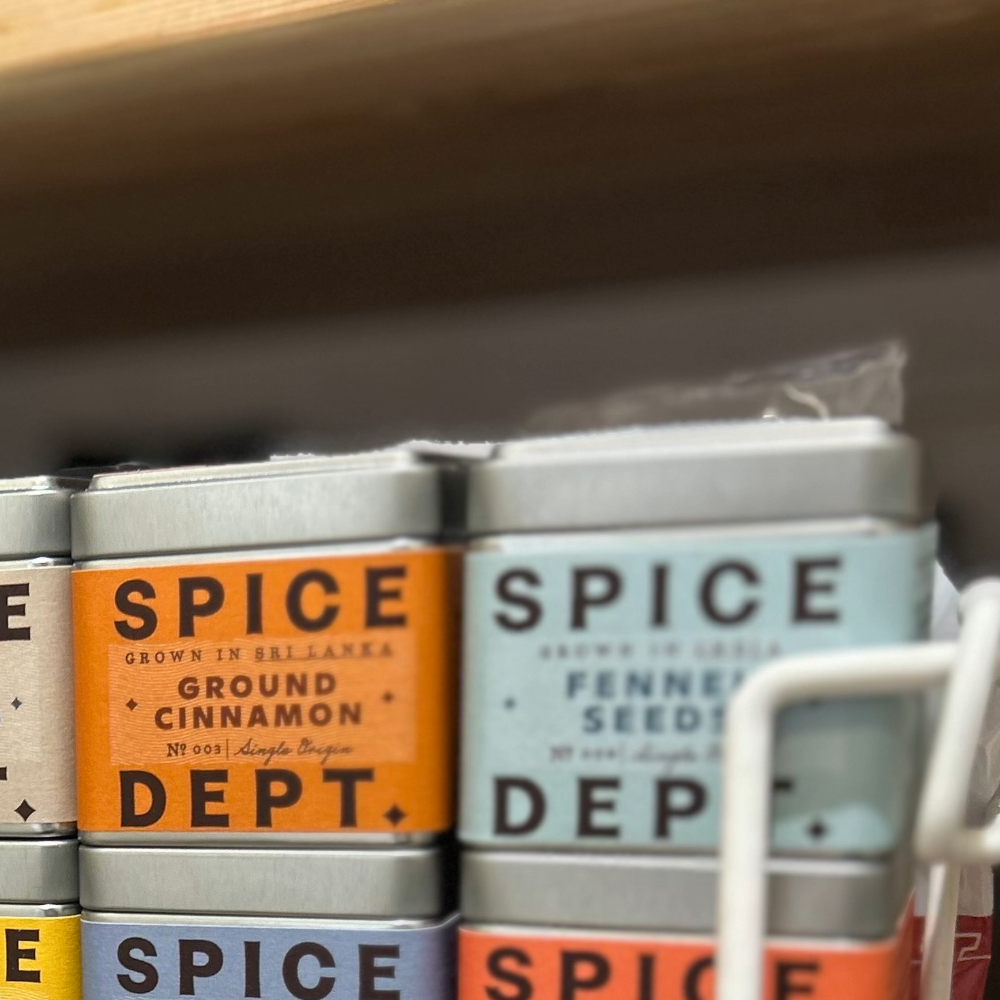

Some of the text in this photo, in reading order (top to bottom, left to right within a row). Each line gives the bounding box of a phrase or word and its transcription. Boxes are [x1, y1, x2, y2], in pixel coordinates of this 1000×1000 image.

[113, 567, 408, 641] SPICE
[493, 554, 842, 633] SPICE
[125, 642, 394, 665] GROWN IN SRI LANKA
[178, 672, 336, 700] GROUND
[155, 702, 361, 730] CINNAMON
[193, 745, 221, 755] 003
[235, 738, 291, 765] Single
[297, 738, 353, 764] Origin
